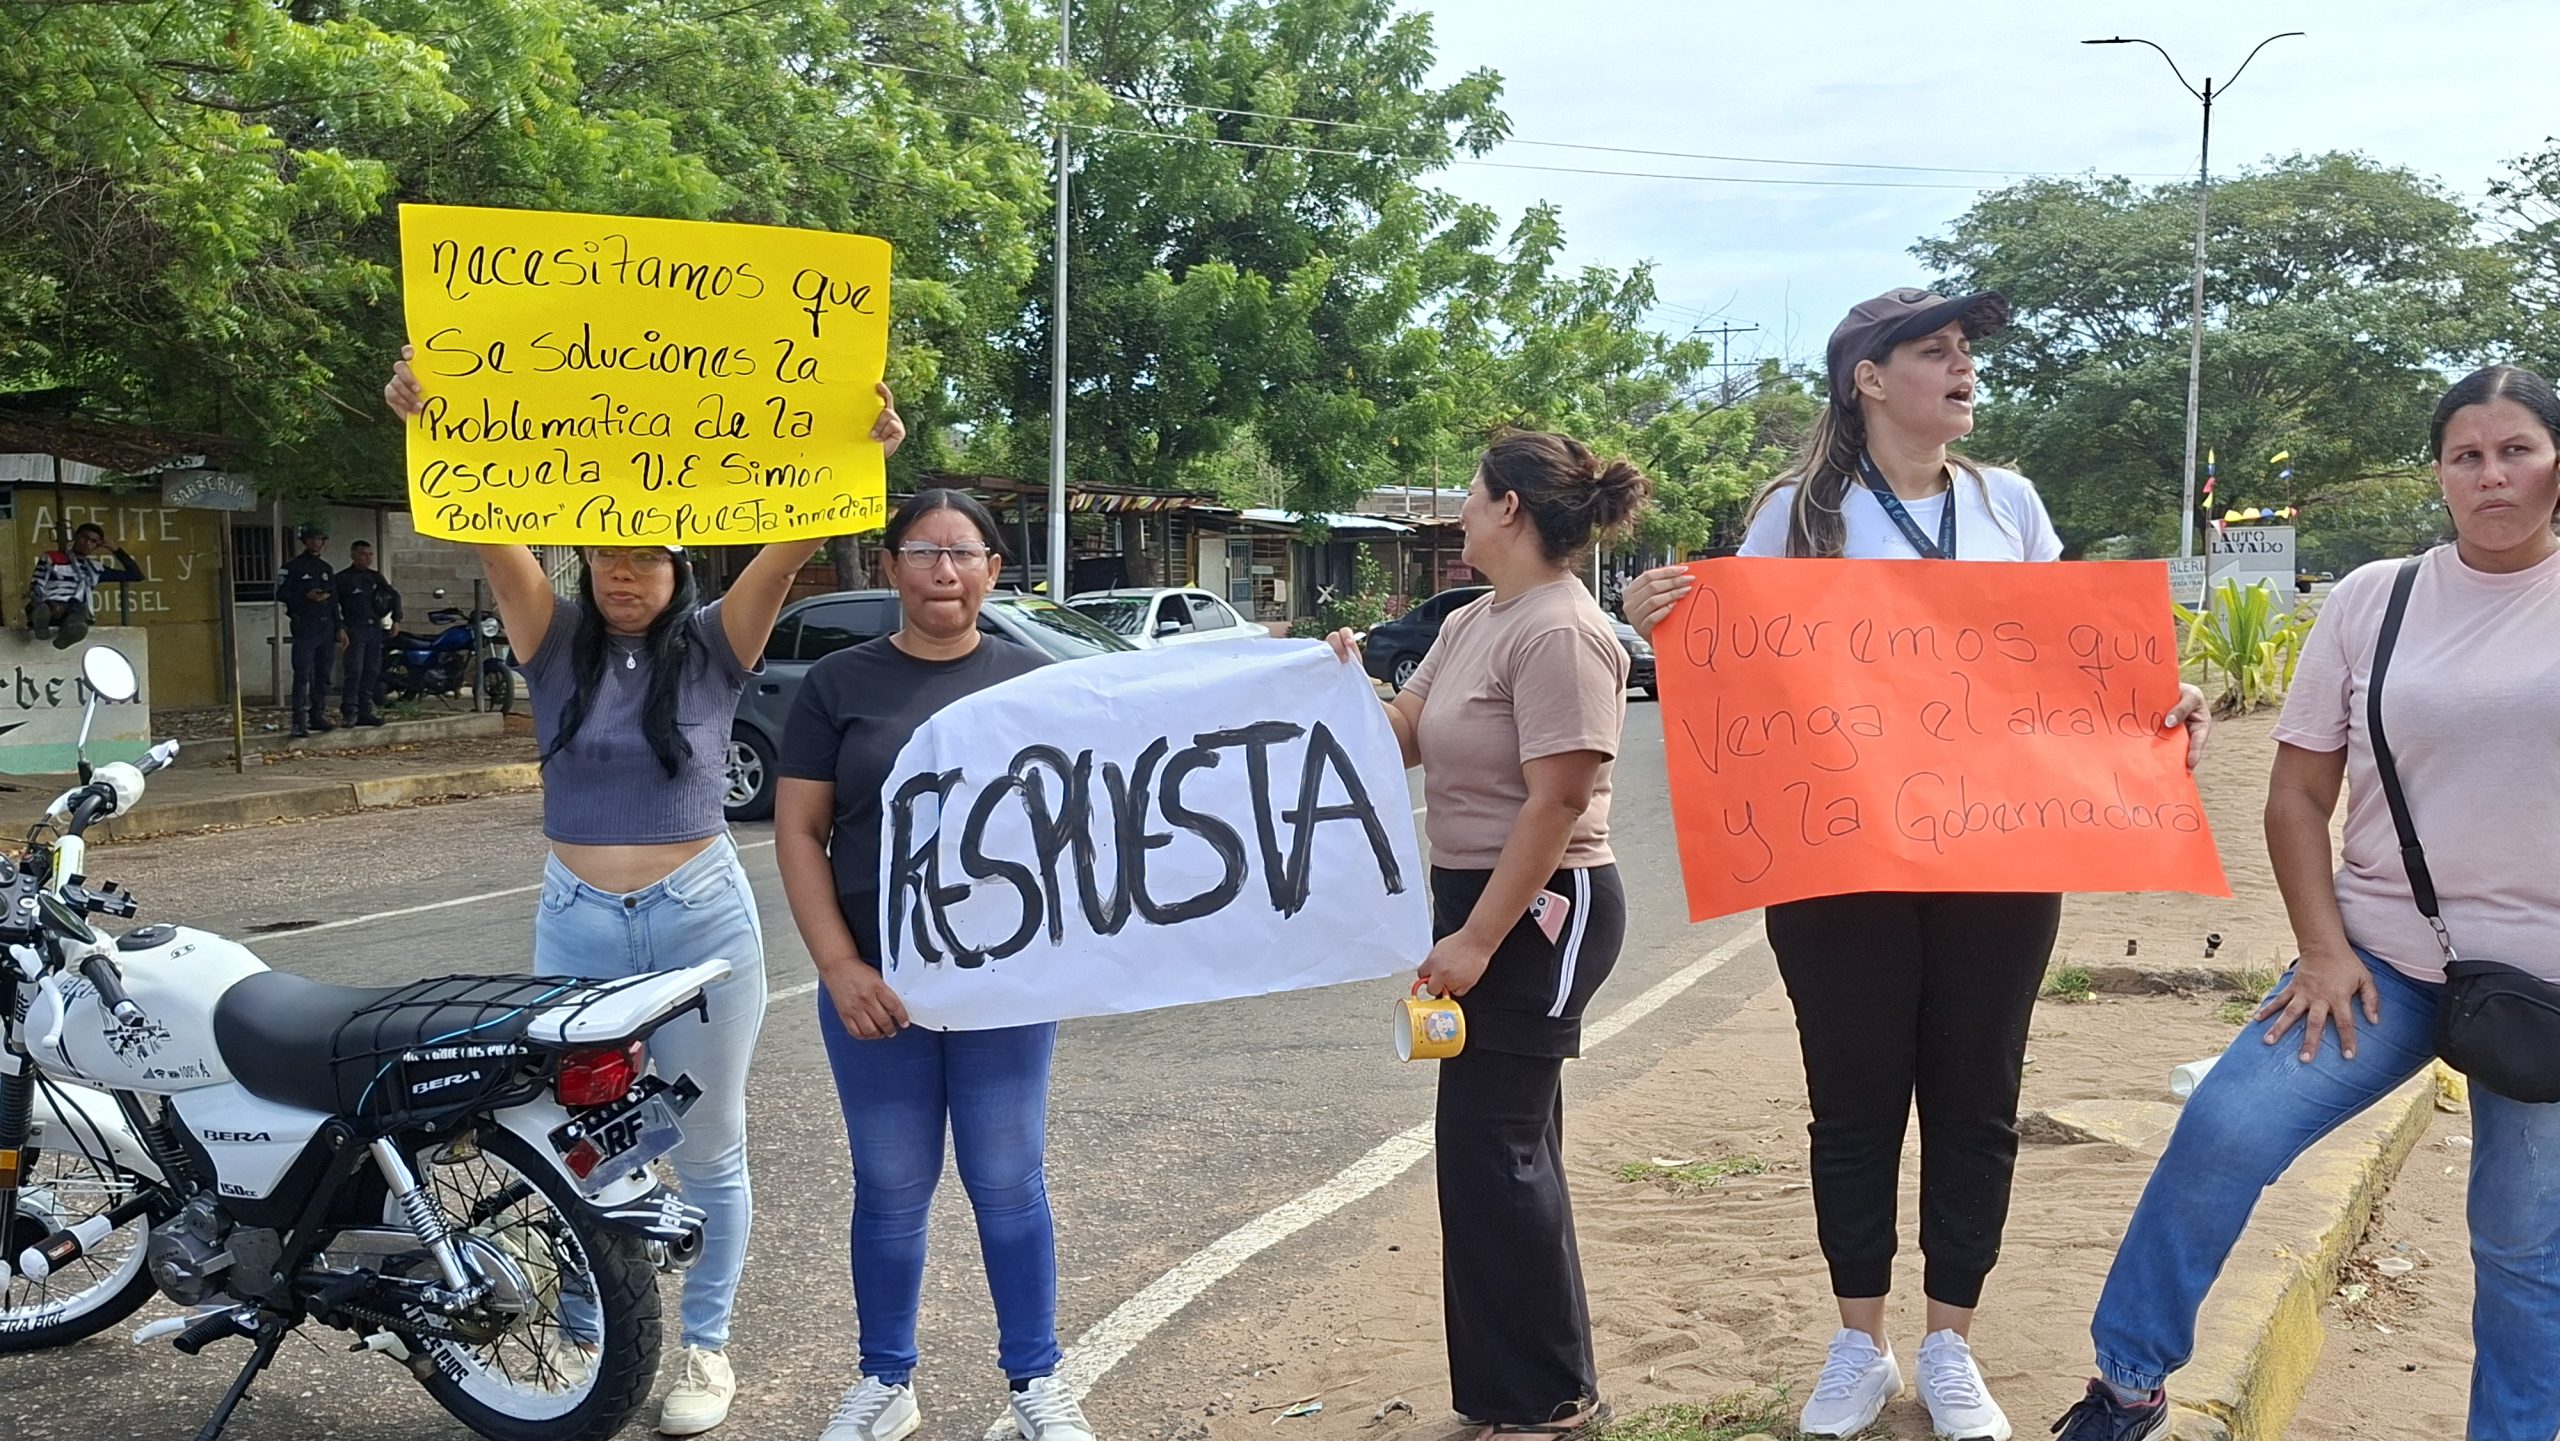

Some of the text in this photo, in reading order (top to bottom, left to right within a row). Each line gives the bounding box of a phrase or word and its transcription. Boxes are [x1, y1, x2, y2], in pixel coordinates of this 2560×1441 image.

[433, 235, 874, 337] necesitamos que
[426, 328, 513, 377] Se
[420, 394, 671, 443] Problematica
[695, 393, 750, 439] de
[420, 449, 601, 499] escuela
[2212, 542, 2283, 554] LAVADO
[2220, 531, 2265, 542] AUTO
[1684, 583, 2165, 690] Queremos que
[1921, 671, 1983, 742] el
[2007, 688, 2171, 742] alcalde
[888, 721, 1406, 970] RESPUESTA
[1723, 769, 2202, 884] y la Gobernadora
[15, 989, 30, 1025] BRF
[412, 1070, 481, 1094] BERA
[203, 1130, 271, 1142] BERA
[658, 1193, 686, 1231] BRF
